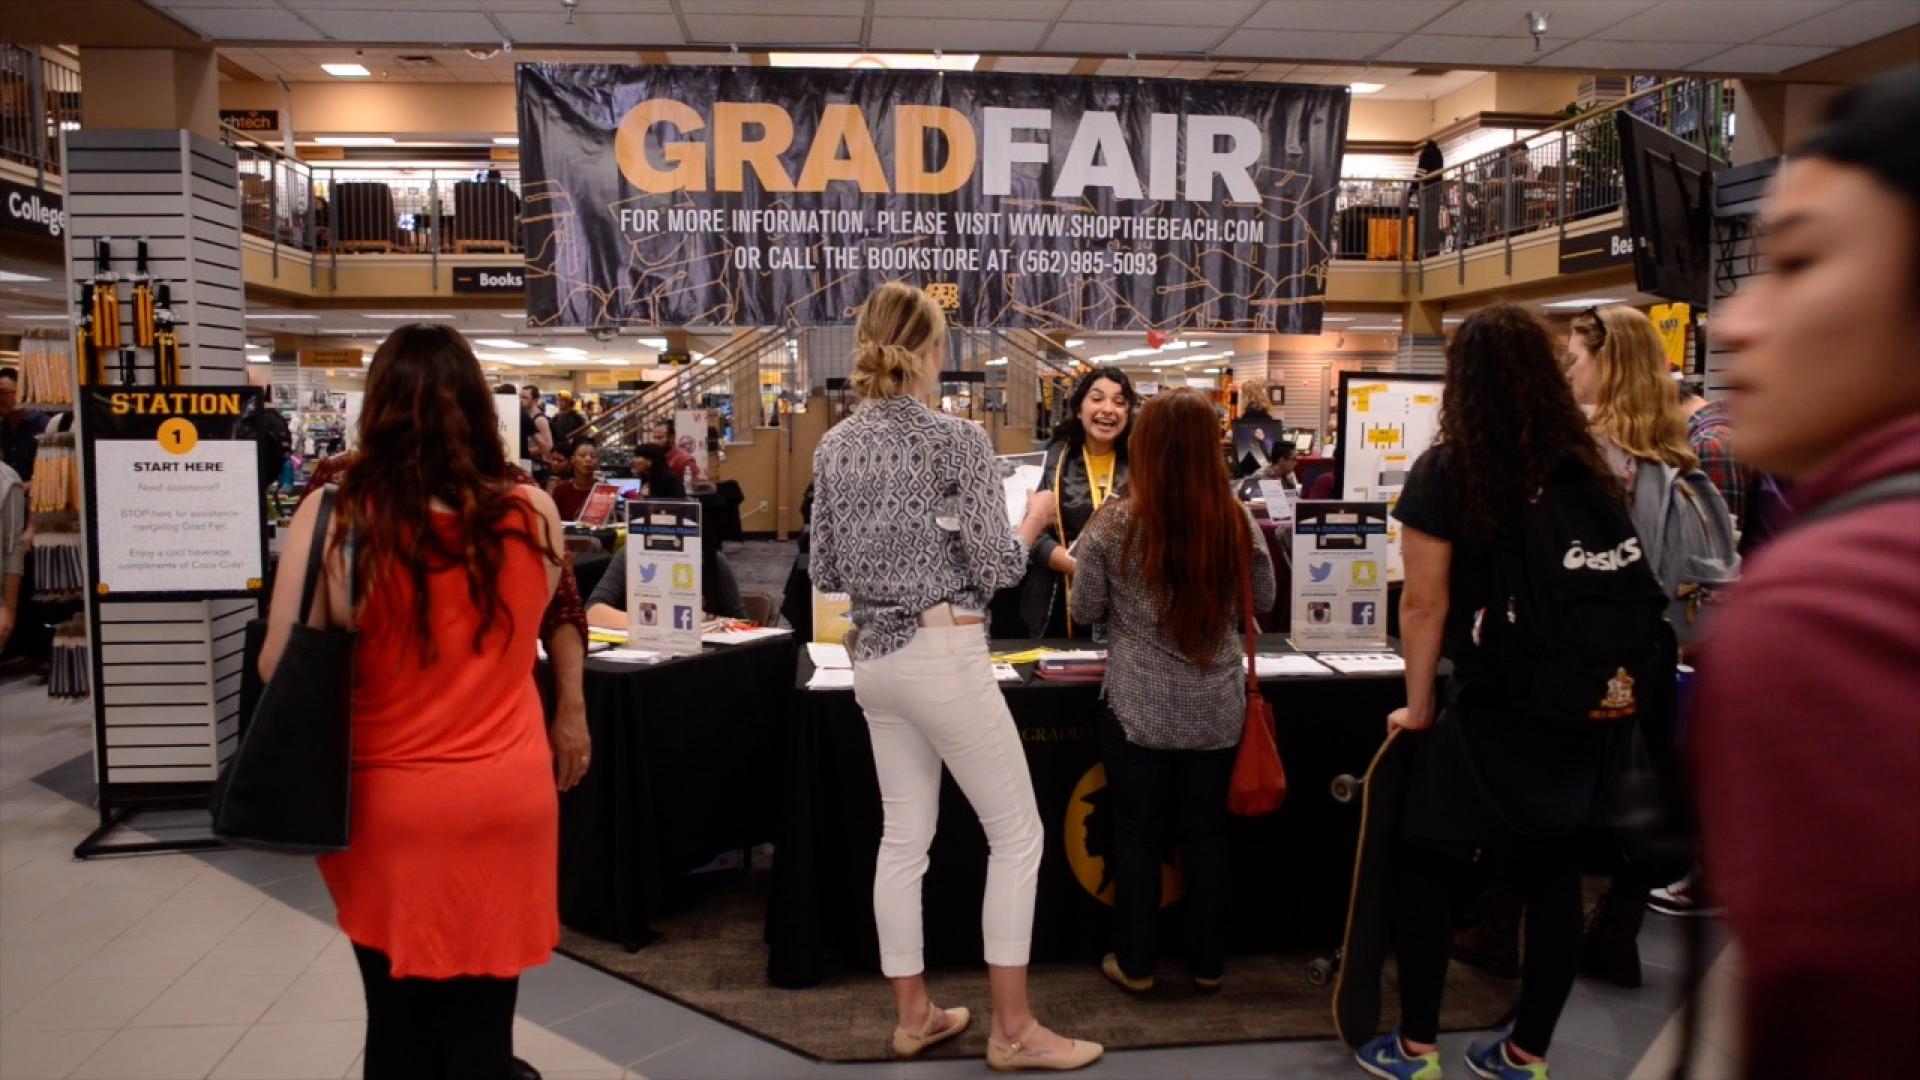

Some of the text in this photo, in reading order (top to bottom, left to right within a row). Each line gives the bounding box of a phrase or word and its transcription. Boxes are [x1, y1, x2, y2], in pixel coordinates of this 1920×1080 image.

[620, 208, 1264, 244] FOR MORE INFORMATION, PLEASE VISIT WWW.SHOPTHEBEACH.COM
[735, 246, 1158, 276] OR CALL THE BOOKSTORE AT (562)985-5093
[479, 271, 523, 287] Books
[111, 392, 241, 415] STATION
[172, 429, 182, 445] 1
[133, 461, 224, 472] START HERE
[138, 482, 220, 492] Need assistance?
[120, 509, 150, 519] STOP
[190, 509, 239, 518] assistance
[132, 522, 179, 533] navigating
[128, 548, 154, 559] Enjoy
[118, 561, 177, 571] compliments
[179, 560, 189, 570] of
